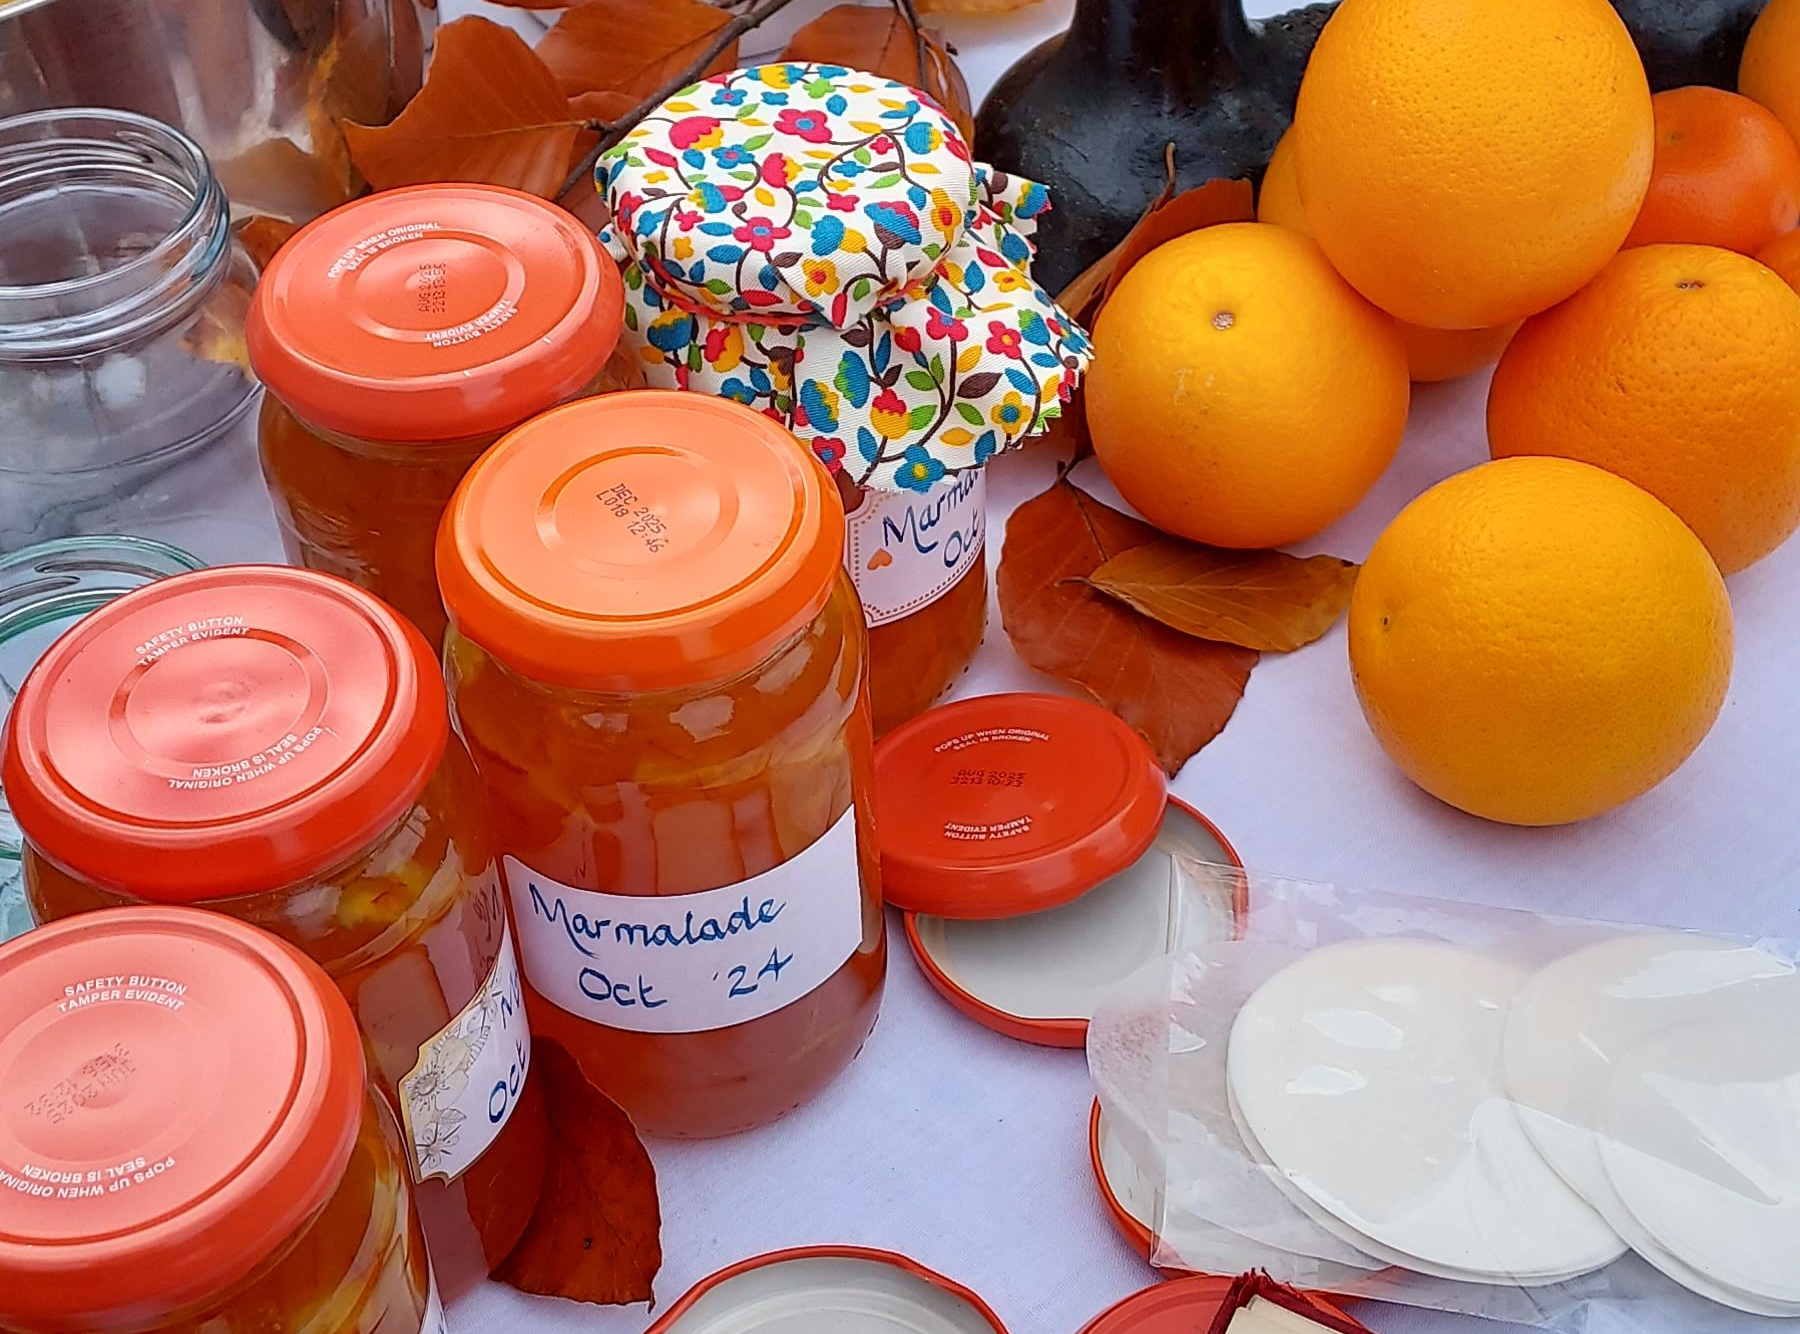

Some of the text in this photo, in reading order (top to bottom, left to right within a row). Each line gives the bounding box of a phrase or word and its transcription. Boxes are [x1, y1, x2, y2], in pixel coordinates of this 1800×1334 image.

[356, 233, 387, 249] WHEN
[388, 222, 440, 237] ORIGINAL
[596, 490, 665, 553] L018 12:46
[610, 483, 667, 534] DEC 2025
[883, 471, 978, 553] Marma
[944, 507, 979, 568] Oct
[135, 616, 244, 654] SAFETY BUTTON
[137, 627, 249, 666] TAMPER EVIDENT
[168, 726, 323, 789] POPS UP WHEN ORIGINAL
[193, 733, 298, 778] SEAL IS BROKEN
[944, 822, 987, 833] EVIDENT
[944, 830, 986, 840] BUTTON
[529, 882, 787, 959] Marmalade
[64, 975, 187, 996] SAFETY BUTTON
[579, 947, 793, 1008] Oct '24
[58, 989, 185, 1012] TAMPER EVIDENT
[0, 1156, 176, 1199] POPS UP WHEN ORIGINA
[21, 1157, 146, 1184] SEAL IS BROKEN
